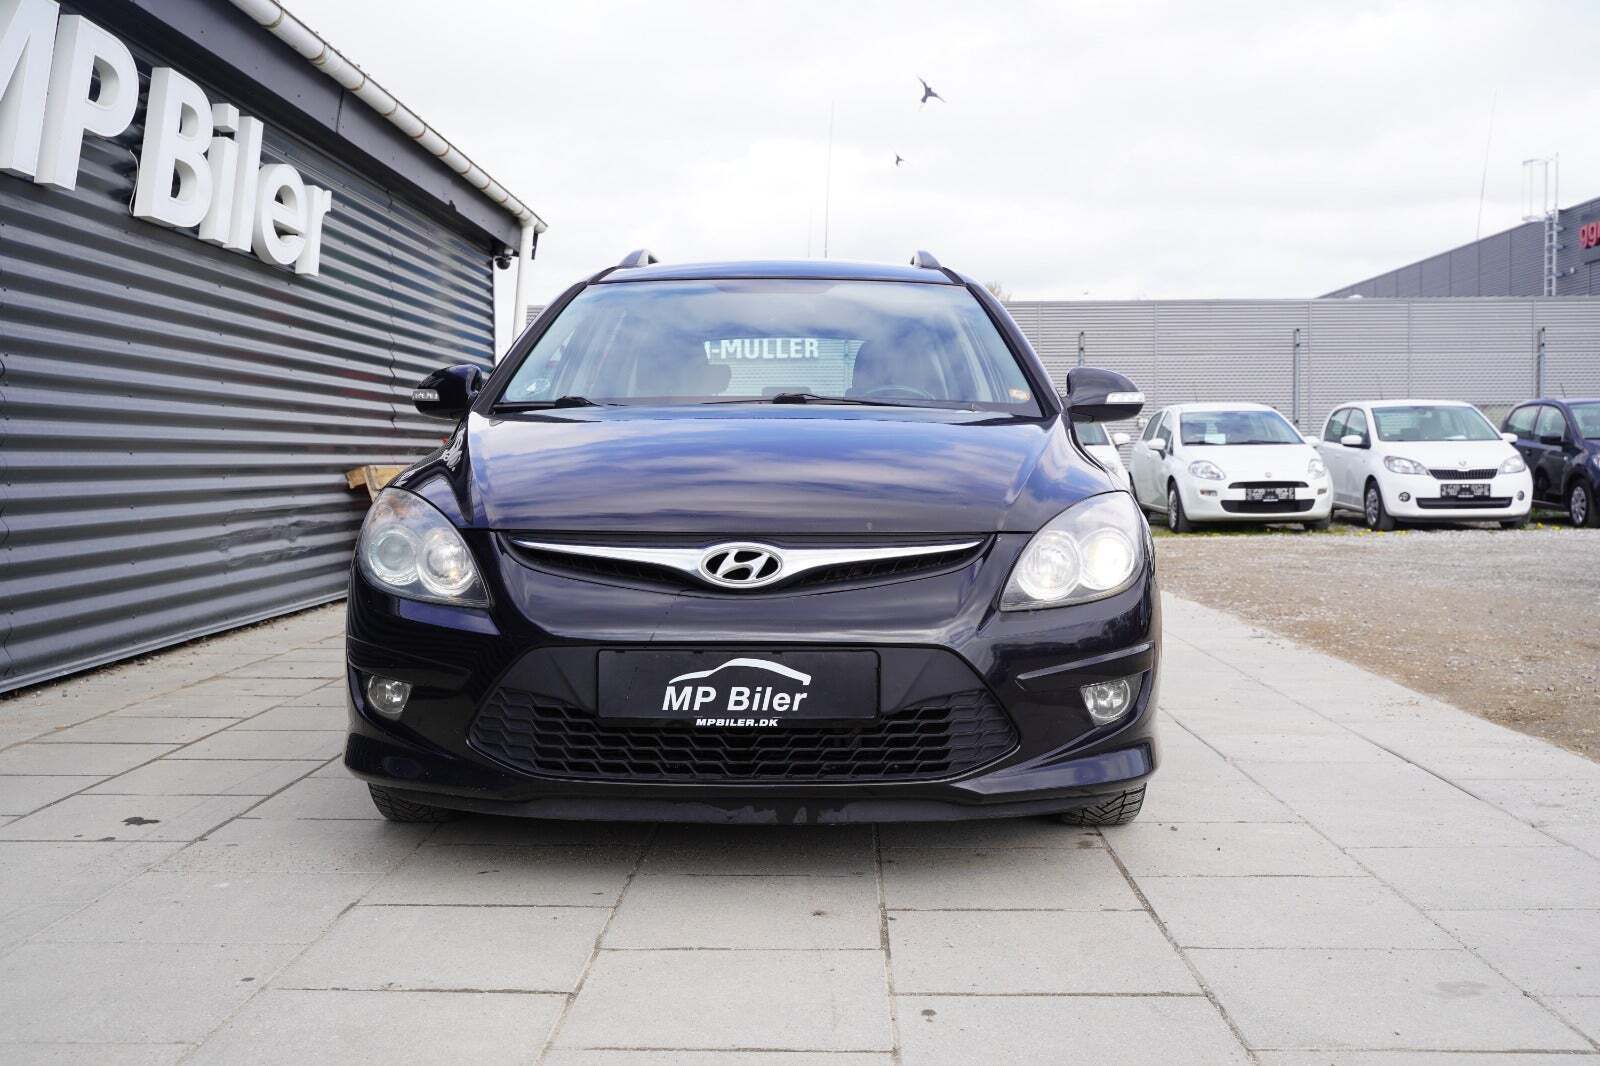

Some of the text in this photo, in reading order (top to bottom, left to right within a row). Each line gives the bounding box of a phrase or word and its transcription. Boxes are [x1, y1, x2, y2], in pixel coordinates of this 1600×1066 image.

[134, 67, 331, 277] Biler
[662, 686, 808, 711] MP Biler
[695, 718, 779, 727] MPBILER.DK
